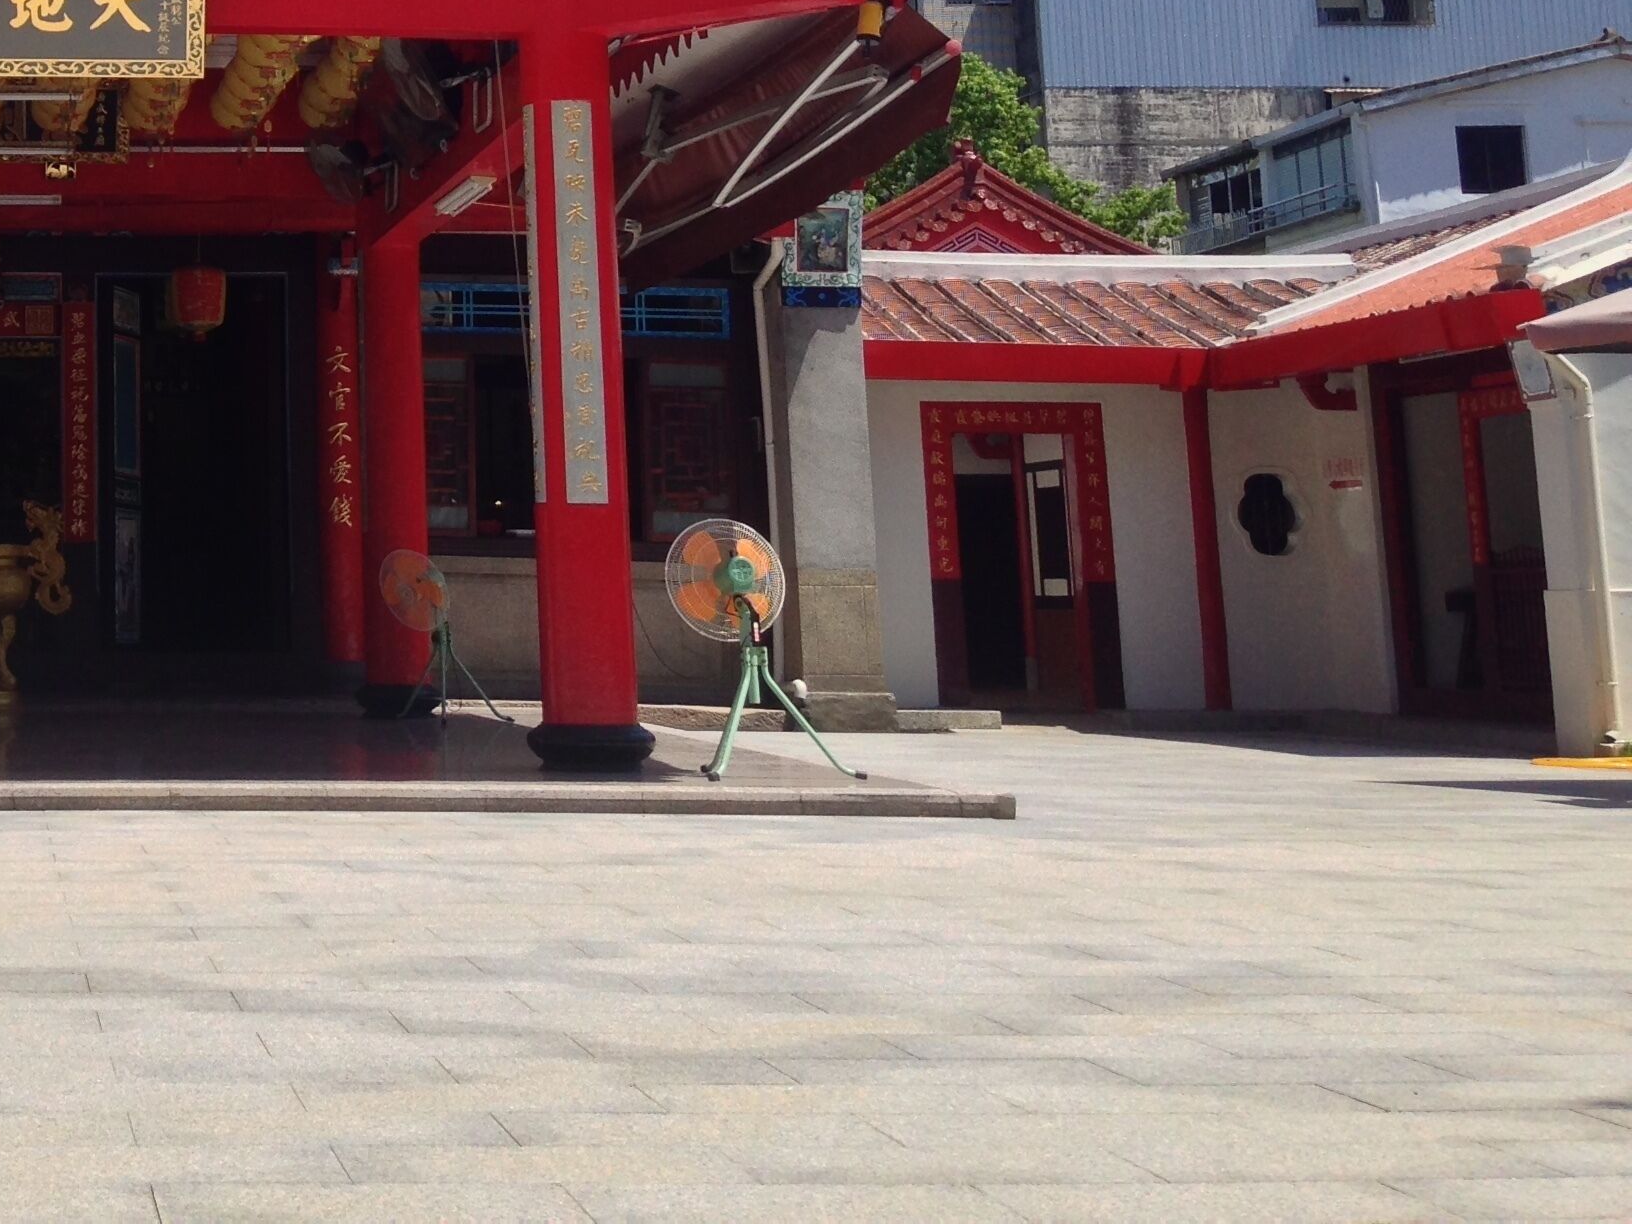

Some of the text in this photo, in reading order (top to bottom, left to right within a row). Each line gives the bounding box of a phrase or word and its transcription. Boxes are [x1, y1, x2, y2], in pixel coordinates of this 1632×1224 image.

[326, 345, 353, 527] 文官不愛錢
